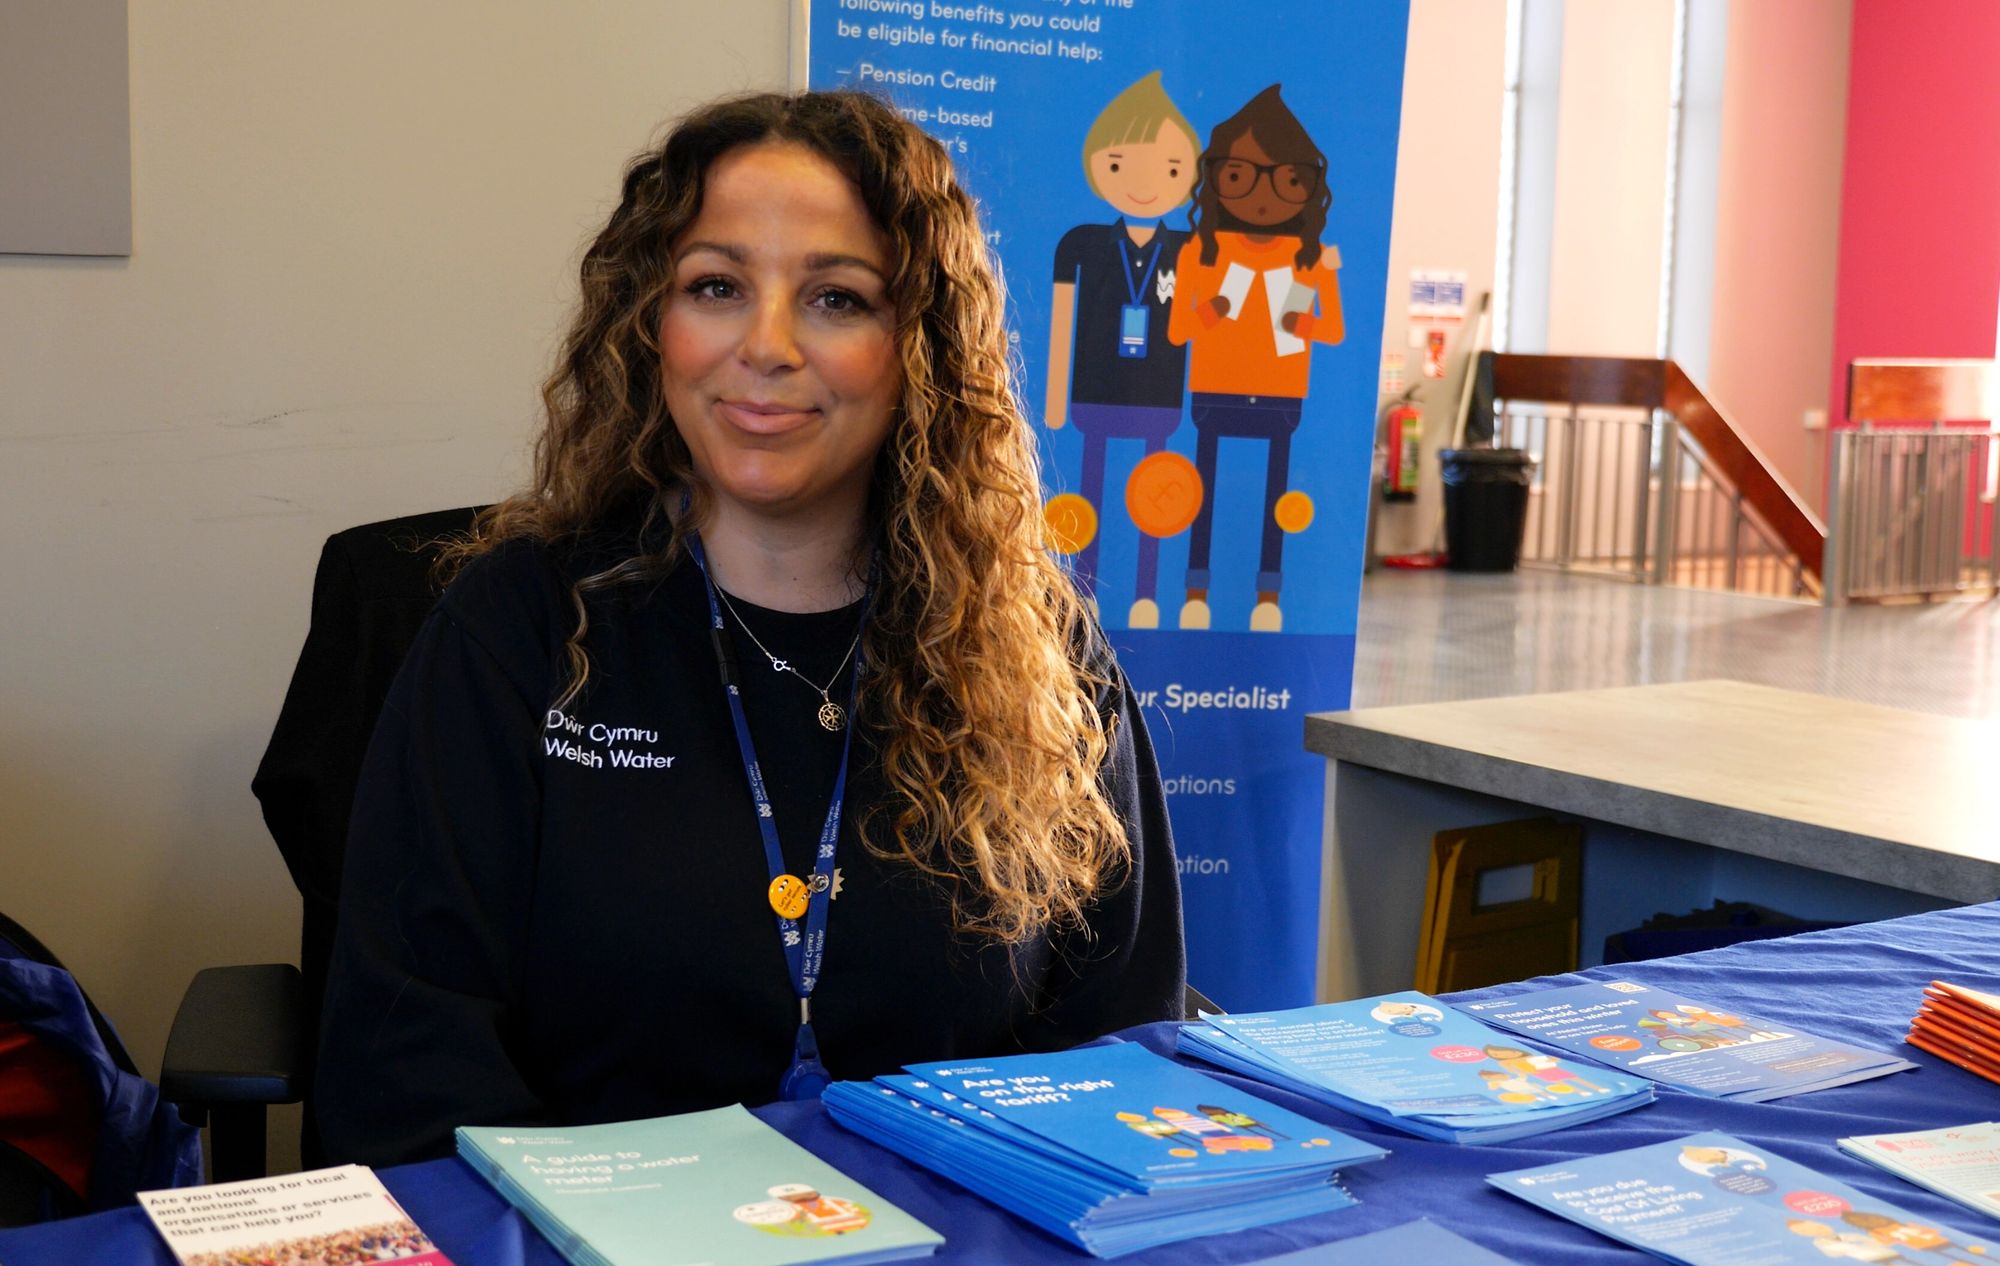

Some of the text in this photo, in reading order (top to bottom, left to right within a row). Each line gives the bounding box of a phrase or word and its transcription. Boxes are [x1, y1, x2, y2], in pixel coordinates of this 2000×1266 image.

[931, 1, 1004, 24] benefits
[1009, 13, 1043, 29] you
[1049, 15, 1100, 33] could
[838, 19, 1103, 63] be eligible for financial help:
[861, 63, 997, 93] Pension Credit
[900, 106, 993, 128] me-based
[1136, 683, 1291, 714] ur Specialist
[589, 723, 658, 747] Cymru
[545, 737, 676, 769] Welsh Water
[1164, 774, 1236, 796] ptions
[1494, 1003, 1572, 1020] Protect your
[1508, 998, 1640, 1025] household and loved
[1526, 1009, 1622, 1030] ones this winter
[962, 1075, 1050, 1089] Are you
[979, 1079, 1115, 1097] on the right
[995, 1092, 1072, 1107] tariff?
[523, 1151, 641, 1166] A guide to
[530, 1154, 700, 1175] having a water
[150, 1173, 348, 1206] Are you looking for local
[545, 1175, 613, 1185] meter
[1552, 1190, 1584, 1201] Are
[1583, 1185, 1614, 1197] you
[1566, 1199, 1588, 1208] to
[1644, 1184, 1676, 1195] the
[157, 1198, 258, 1216] and national
[163, 1192, 373, 1227] organisations or services
[1583, 1203, 1626, 1216] Cost
[170, 1210, 322, 1237] that can help you?
